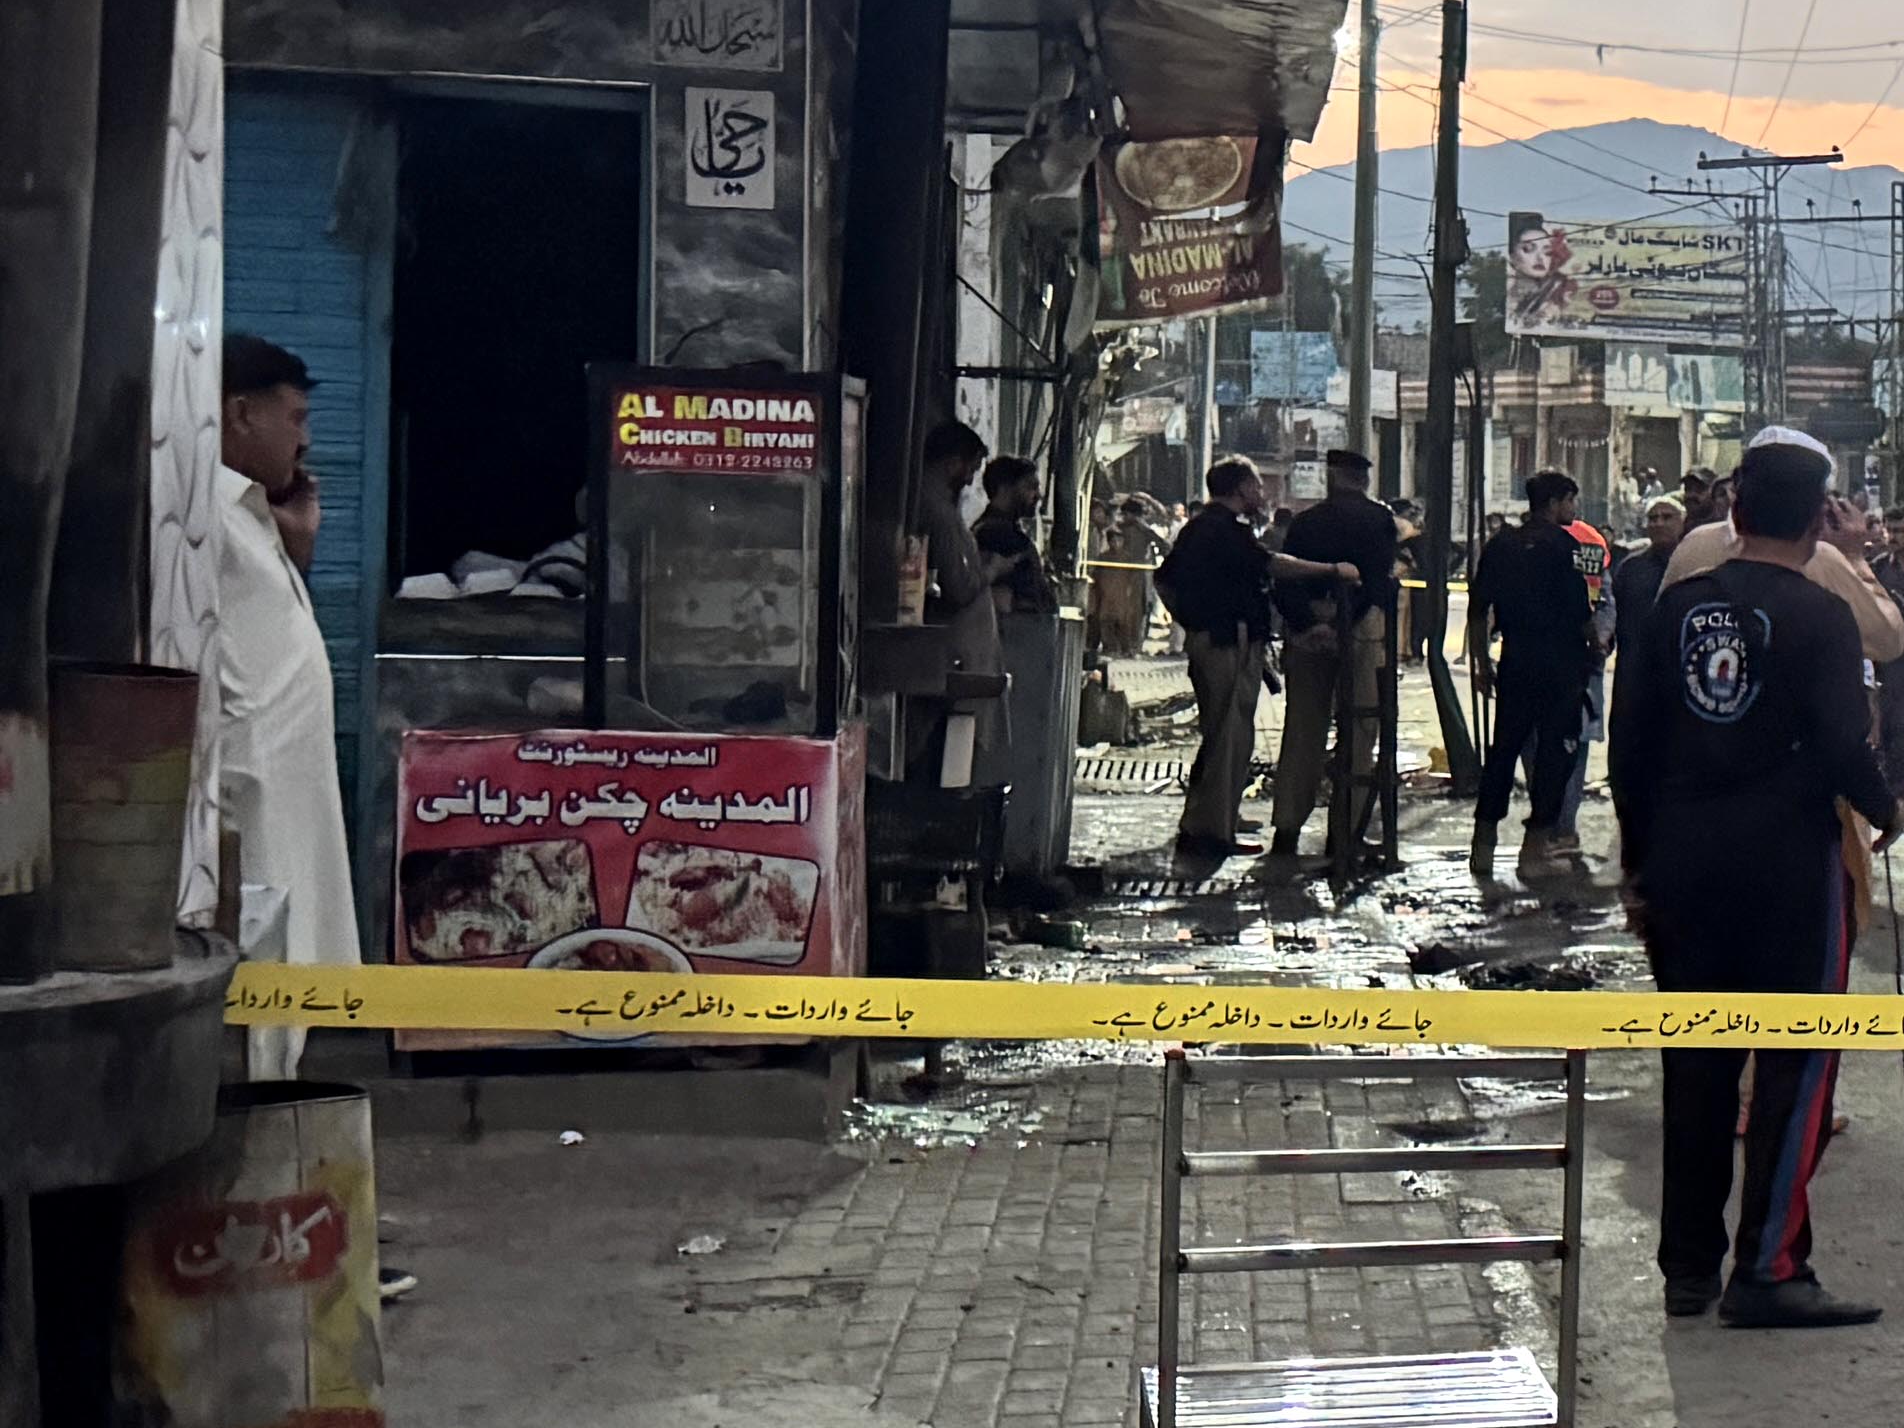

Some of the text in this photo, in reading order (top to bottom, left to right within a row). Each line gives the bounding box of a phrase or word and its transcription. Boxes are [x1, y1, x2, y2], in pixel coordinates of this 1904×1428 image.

[618, 393, 815, 422] AL MADINA
[416, 778, 812, 834] المدینہ چکن بریانی
